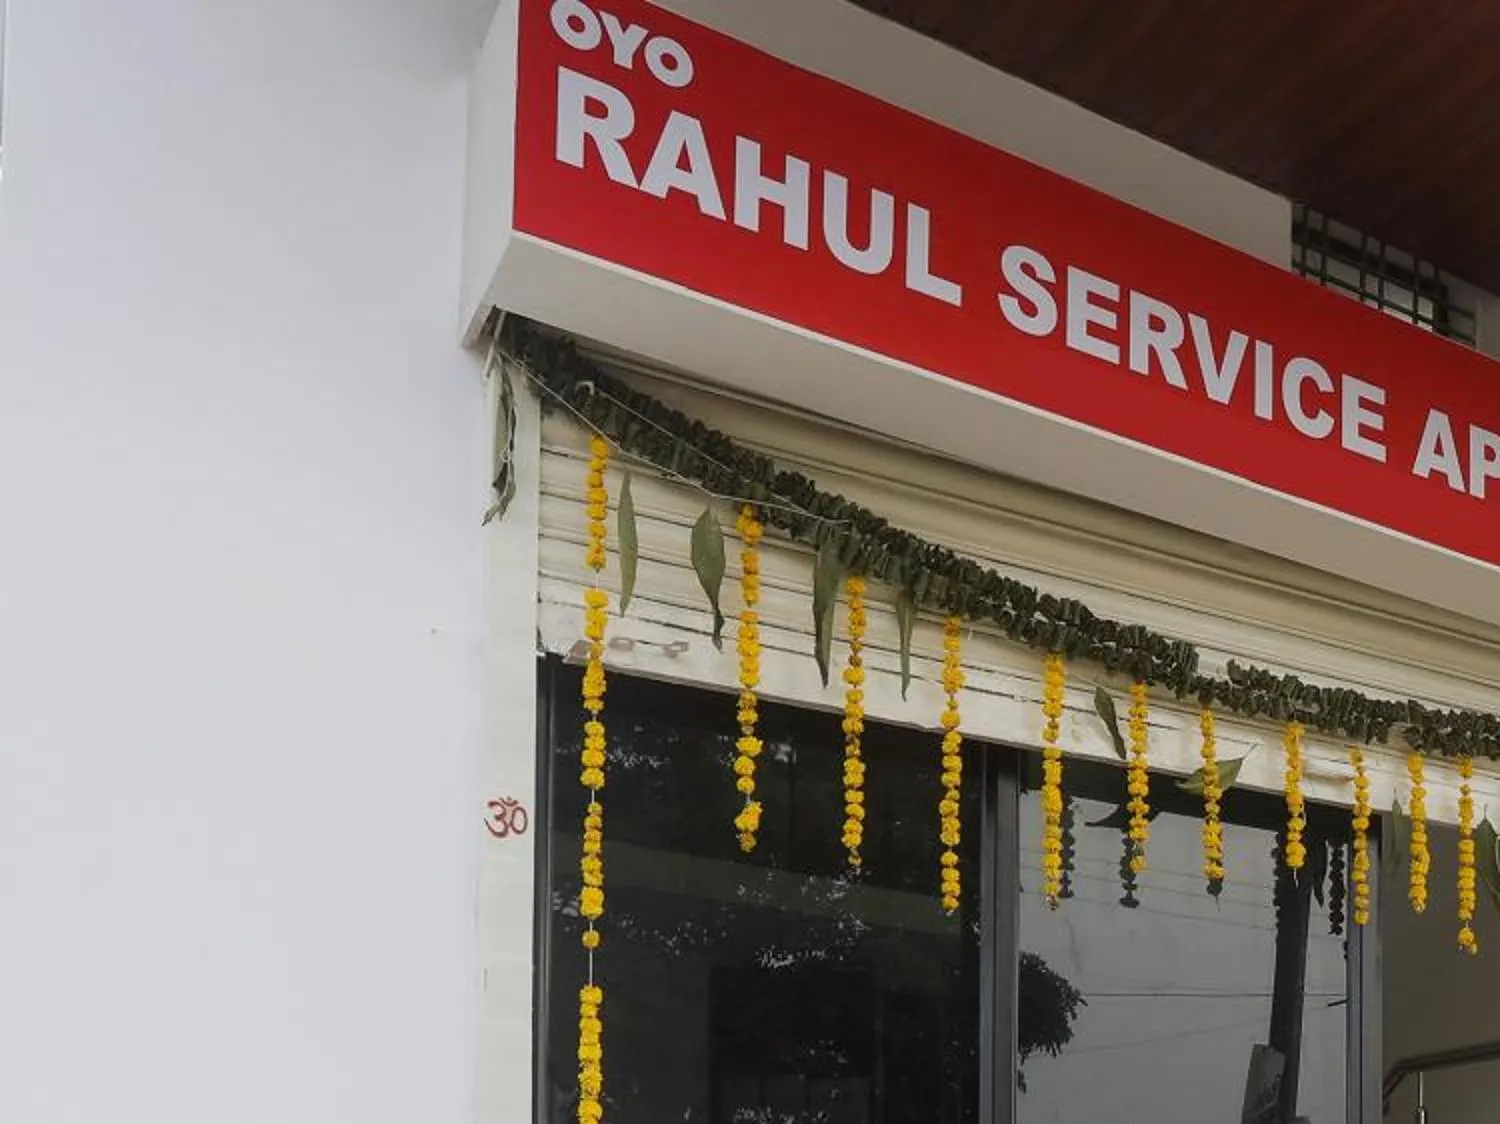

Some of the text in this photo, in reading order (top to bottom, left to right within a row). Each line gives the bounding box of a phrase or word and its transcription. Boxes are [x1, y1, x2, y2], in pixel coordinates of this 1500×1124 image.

[549, 0, 695, 88] OYO
[555, 65, 963, 307] RAHUL
[997, 244, 1388, 464] SERVICE
